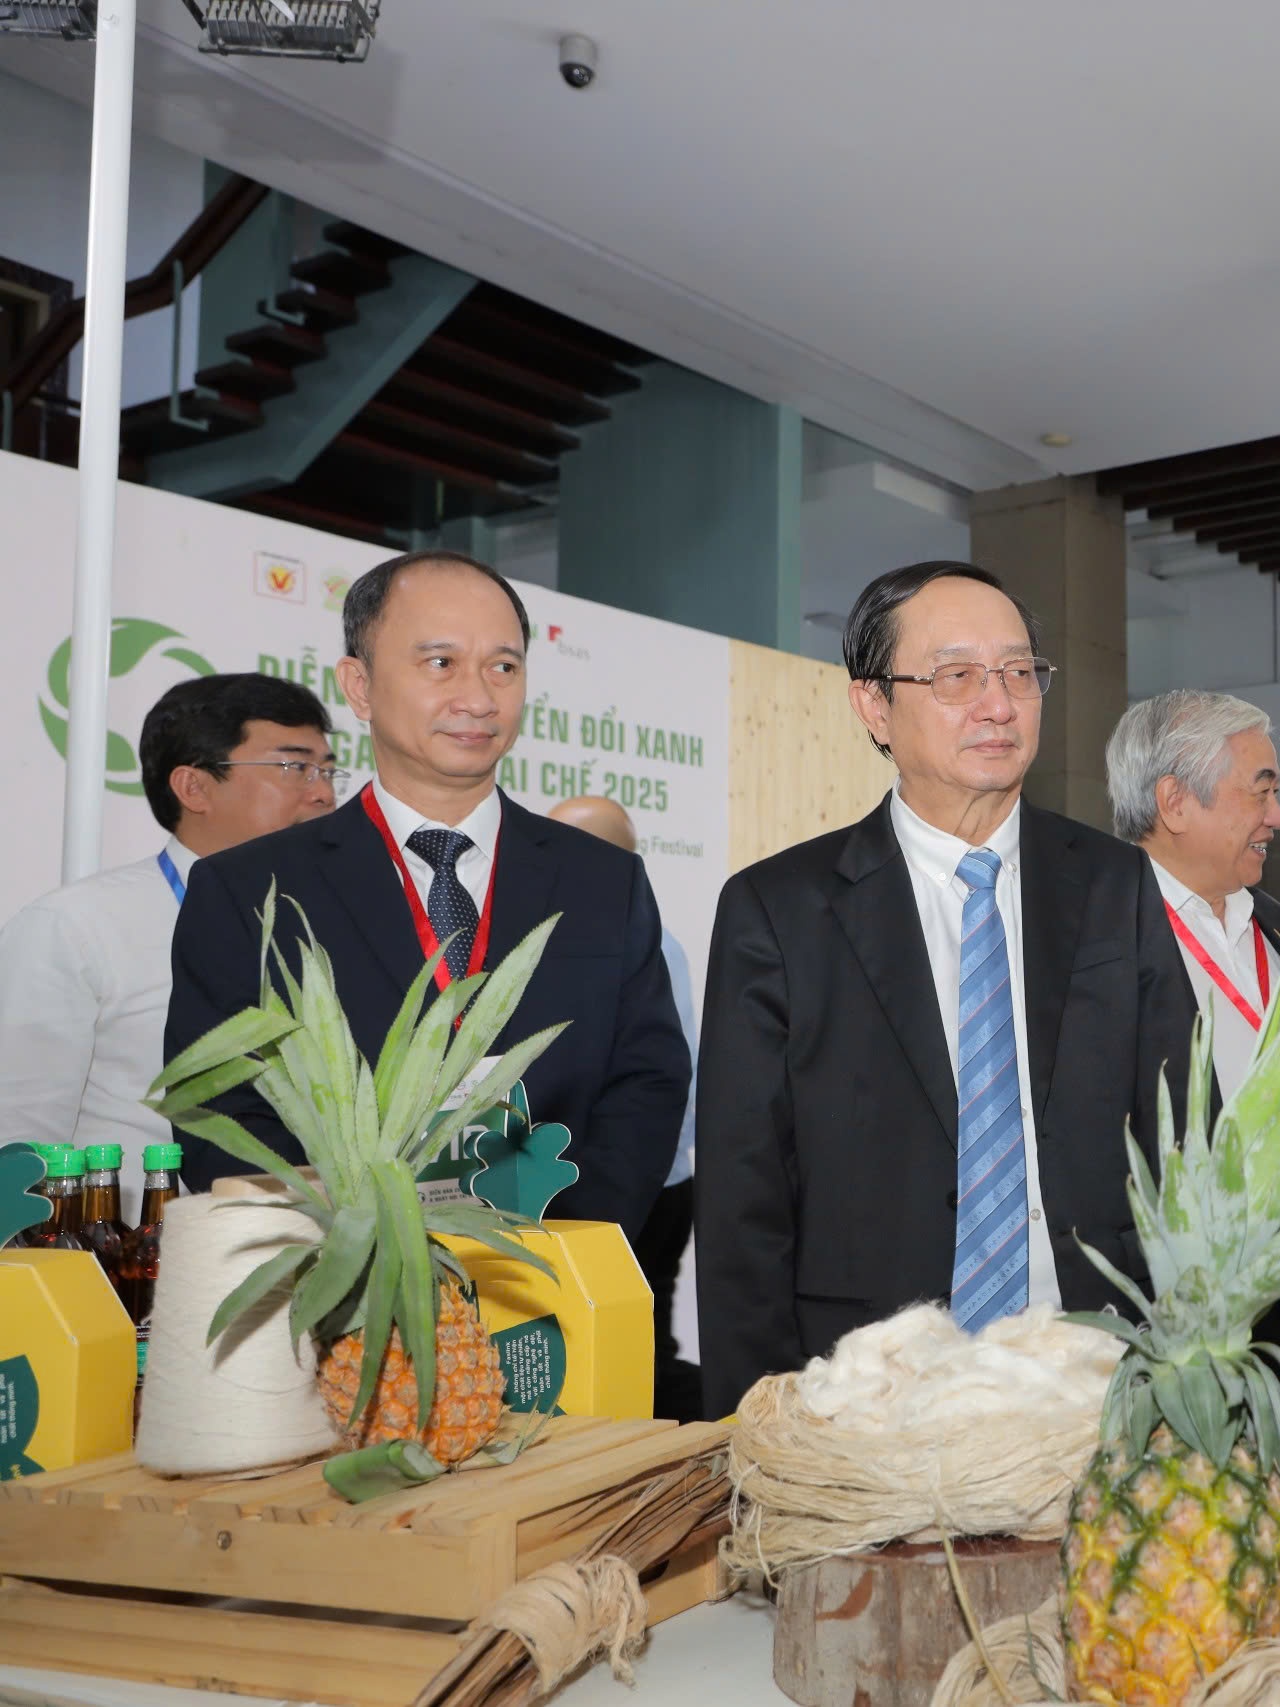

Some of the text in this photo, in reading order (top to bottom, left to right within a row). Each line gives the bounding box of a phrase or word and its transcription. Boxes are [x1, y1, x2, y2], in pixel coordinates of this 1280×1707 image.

[518, 691, 569, 744] YỂN
[580, 705, 626, 753] ĐỔI
[636, 724, 704, 768] XANH
[541, 758, 599, 798] CHẾ
[604, 771, 669, 813] 2025
[651, 835, 704, 859] Festival
